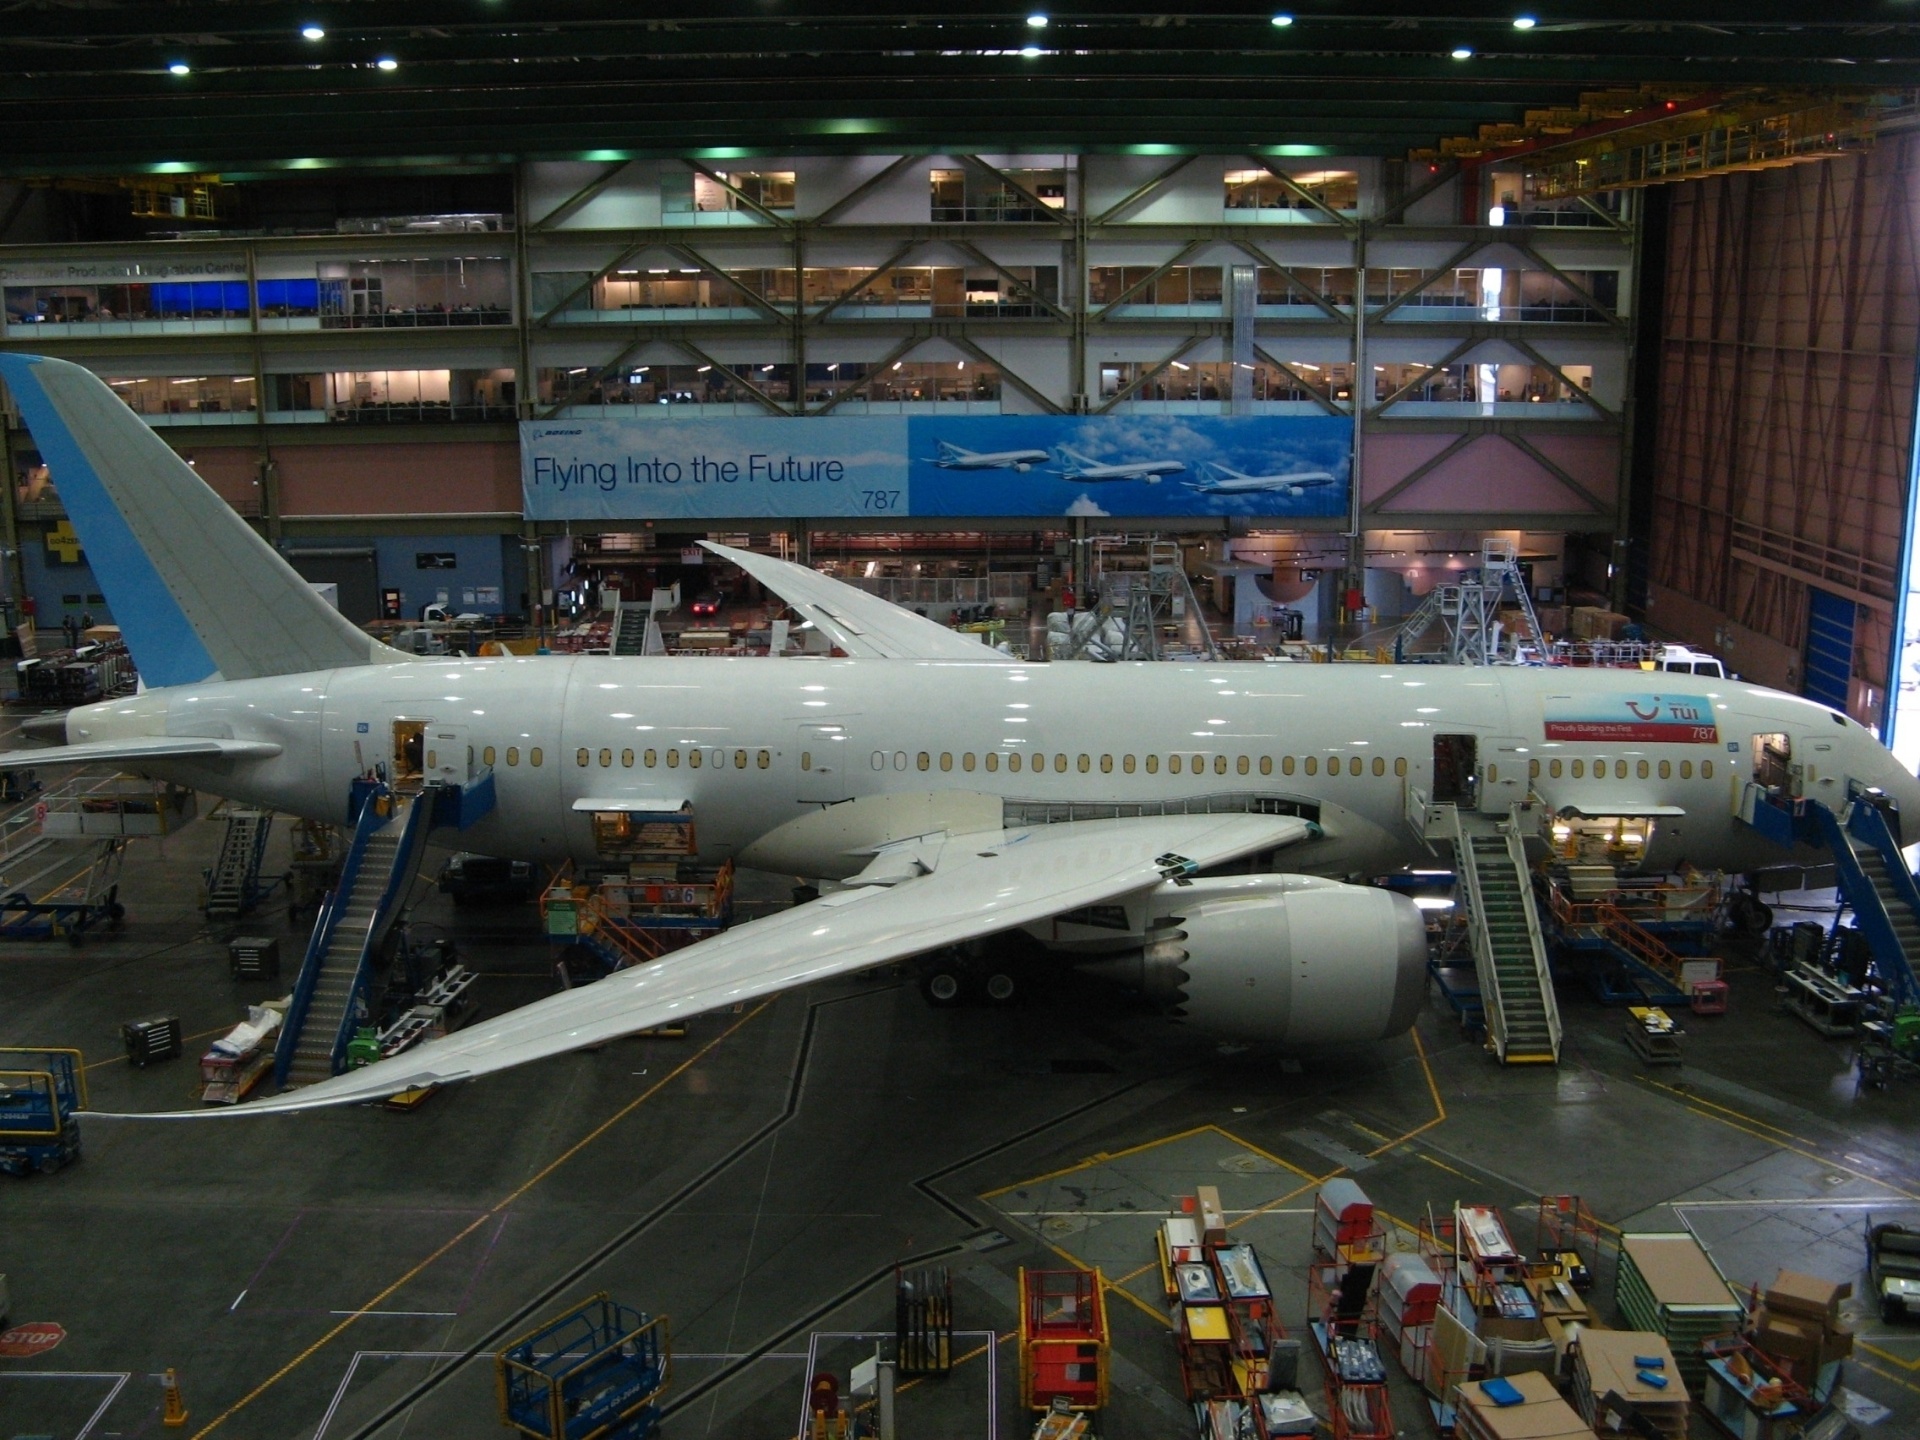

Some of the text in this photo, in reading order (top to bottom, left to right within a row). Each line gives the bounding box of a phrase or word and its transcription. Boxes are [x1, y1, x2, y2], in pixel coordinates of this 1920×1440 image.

[205, 262, 247, 274] Center
[534, 454, 844, 491] Flying Into the Future
[862, 490, 900, 509] 787
[682, 548, 700, 556] EXIT
[1670, 708, 1699, 720] TUI
[1551, 724, 1632, 733] Proudly Building the First
[1691, 727, 1715, 740] 787
[684, 888, 694, 903] 6
[1, 1332, 60, 1344] STOP
